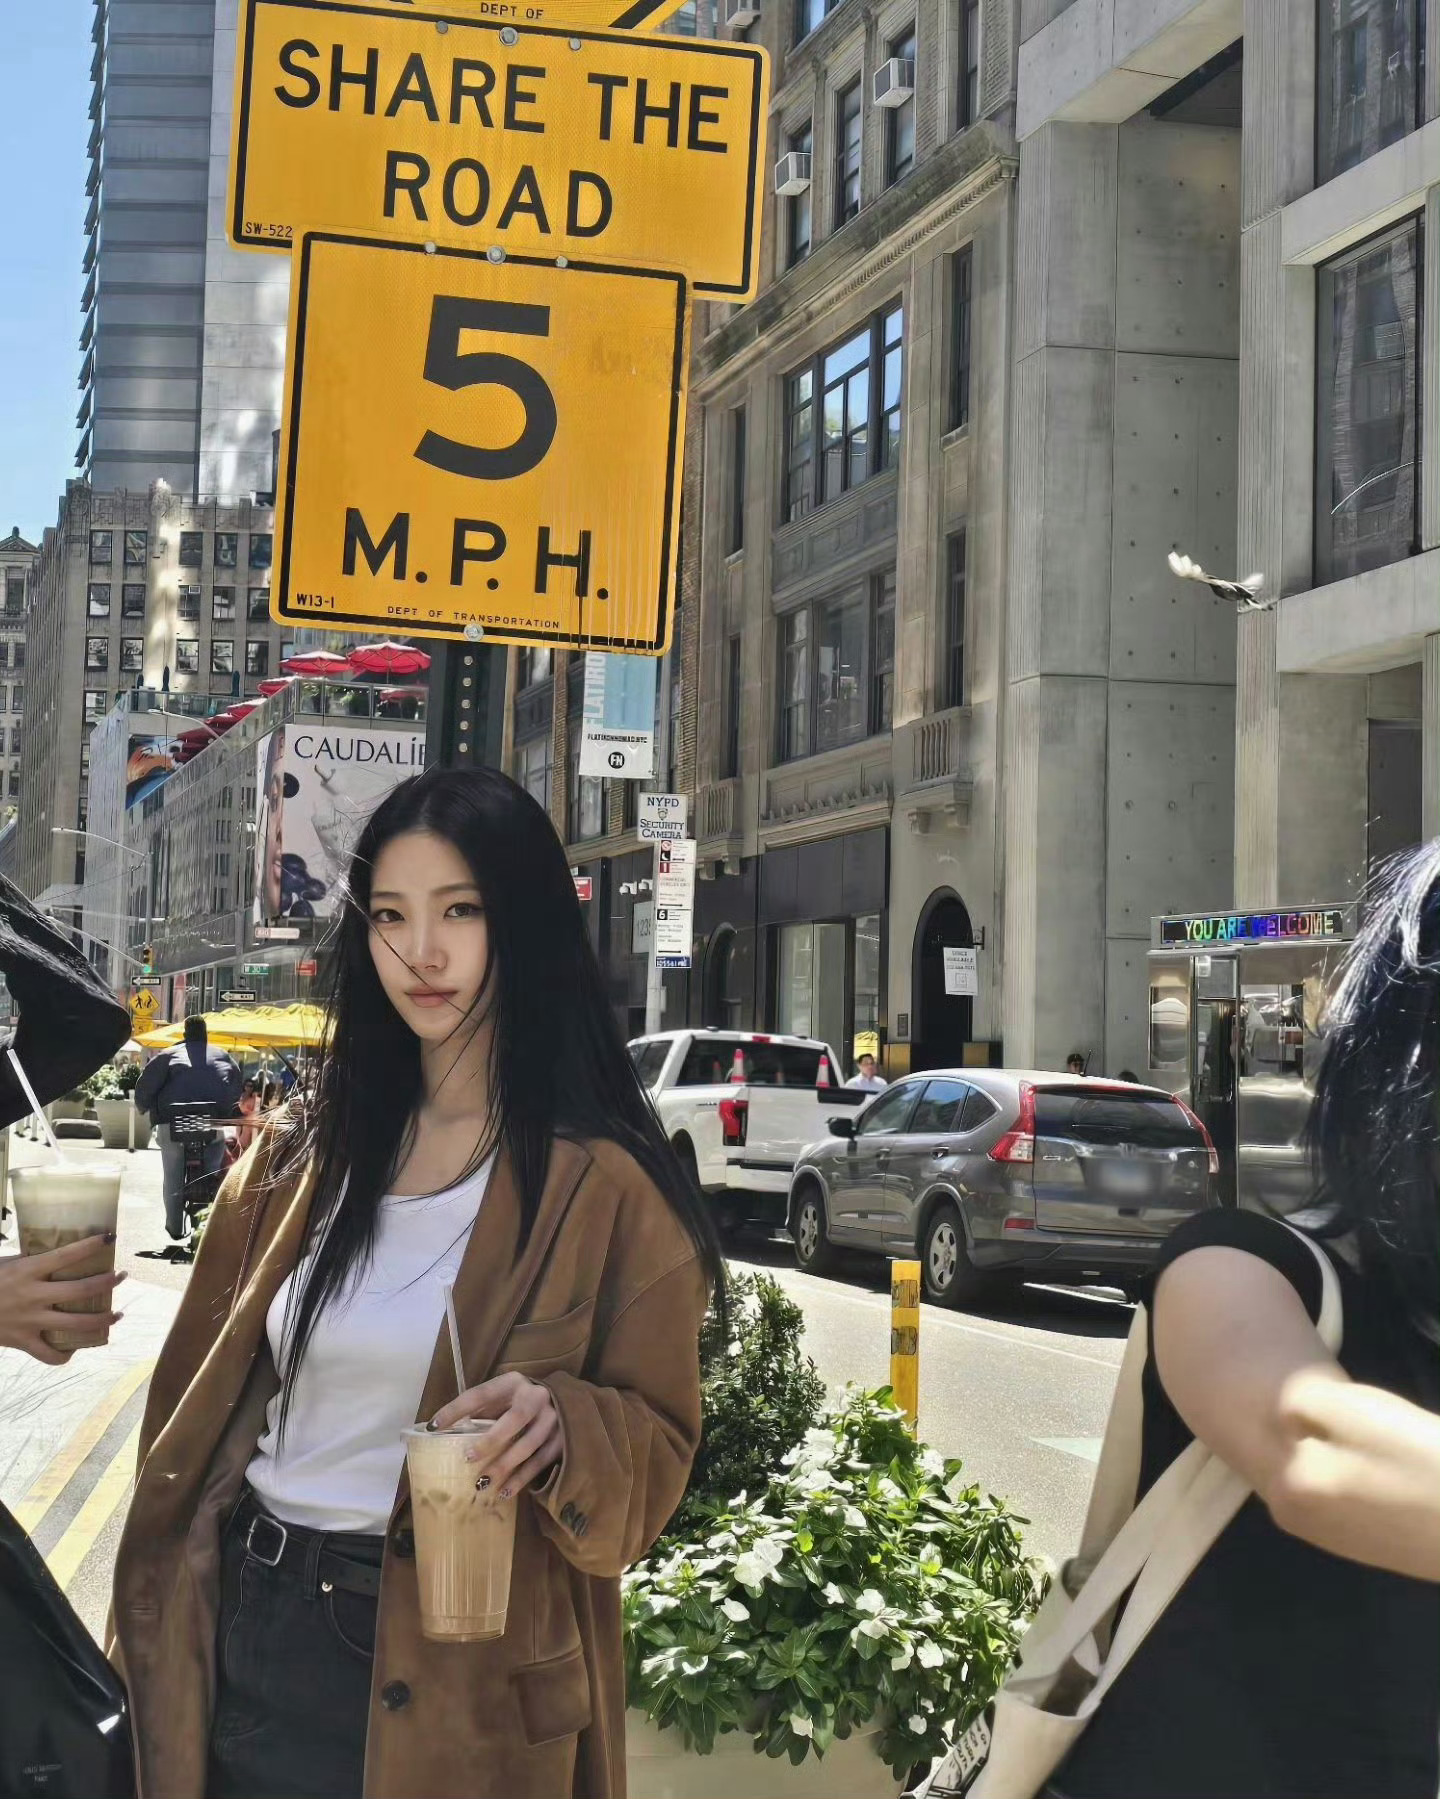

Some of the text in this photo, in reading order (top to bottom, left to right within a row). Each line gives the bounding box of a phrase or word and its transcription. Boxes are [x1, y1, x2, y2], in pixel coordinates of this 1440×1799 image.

[480, 1, 545, 19] DEPT OF
[274, 39, 729, 154] SHARE THE
[382, 149, 613, 239] ROAD
[245, 221, 293, 238] SW-522
[414, 295, 557, 481] 5
[341, 506, 609, 600] M.P.H.
[296, 592, 335, 609] W13-1
[387, 605, 560, 630] DEPT OF TRANSPORTATION
[647, 796, 680, 808] NYPD
[640, 818, 685, 830] SECURITY
[641, 828, 682, 839] CAMERA
[1185, 911, 1335, 941] YOU ARE WELCOME
